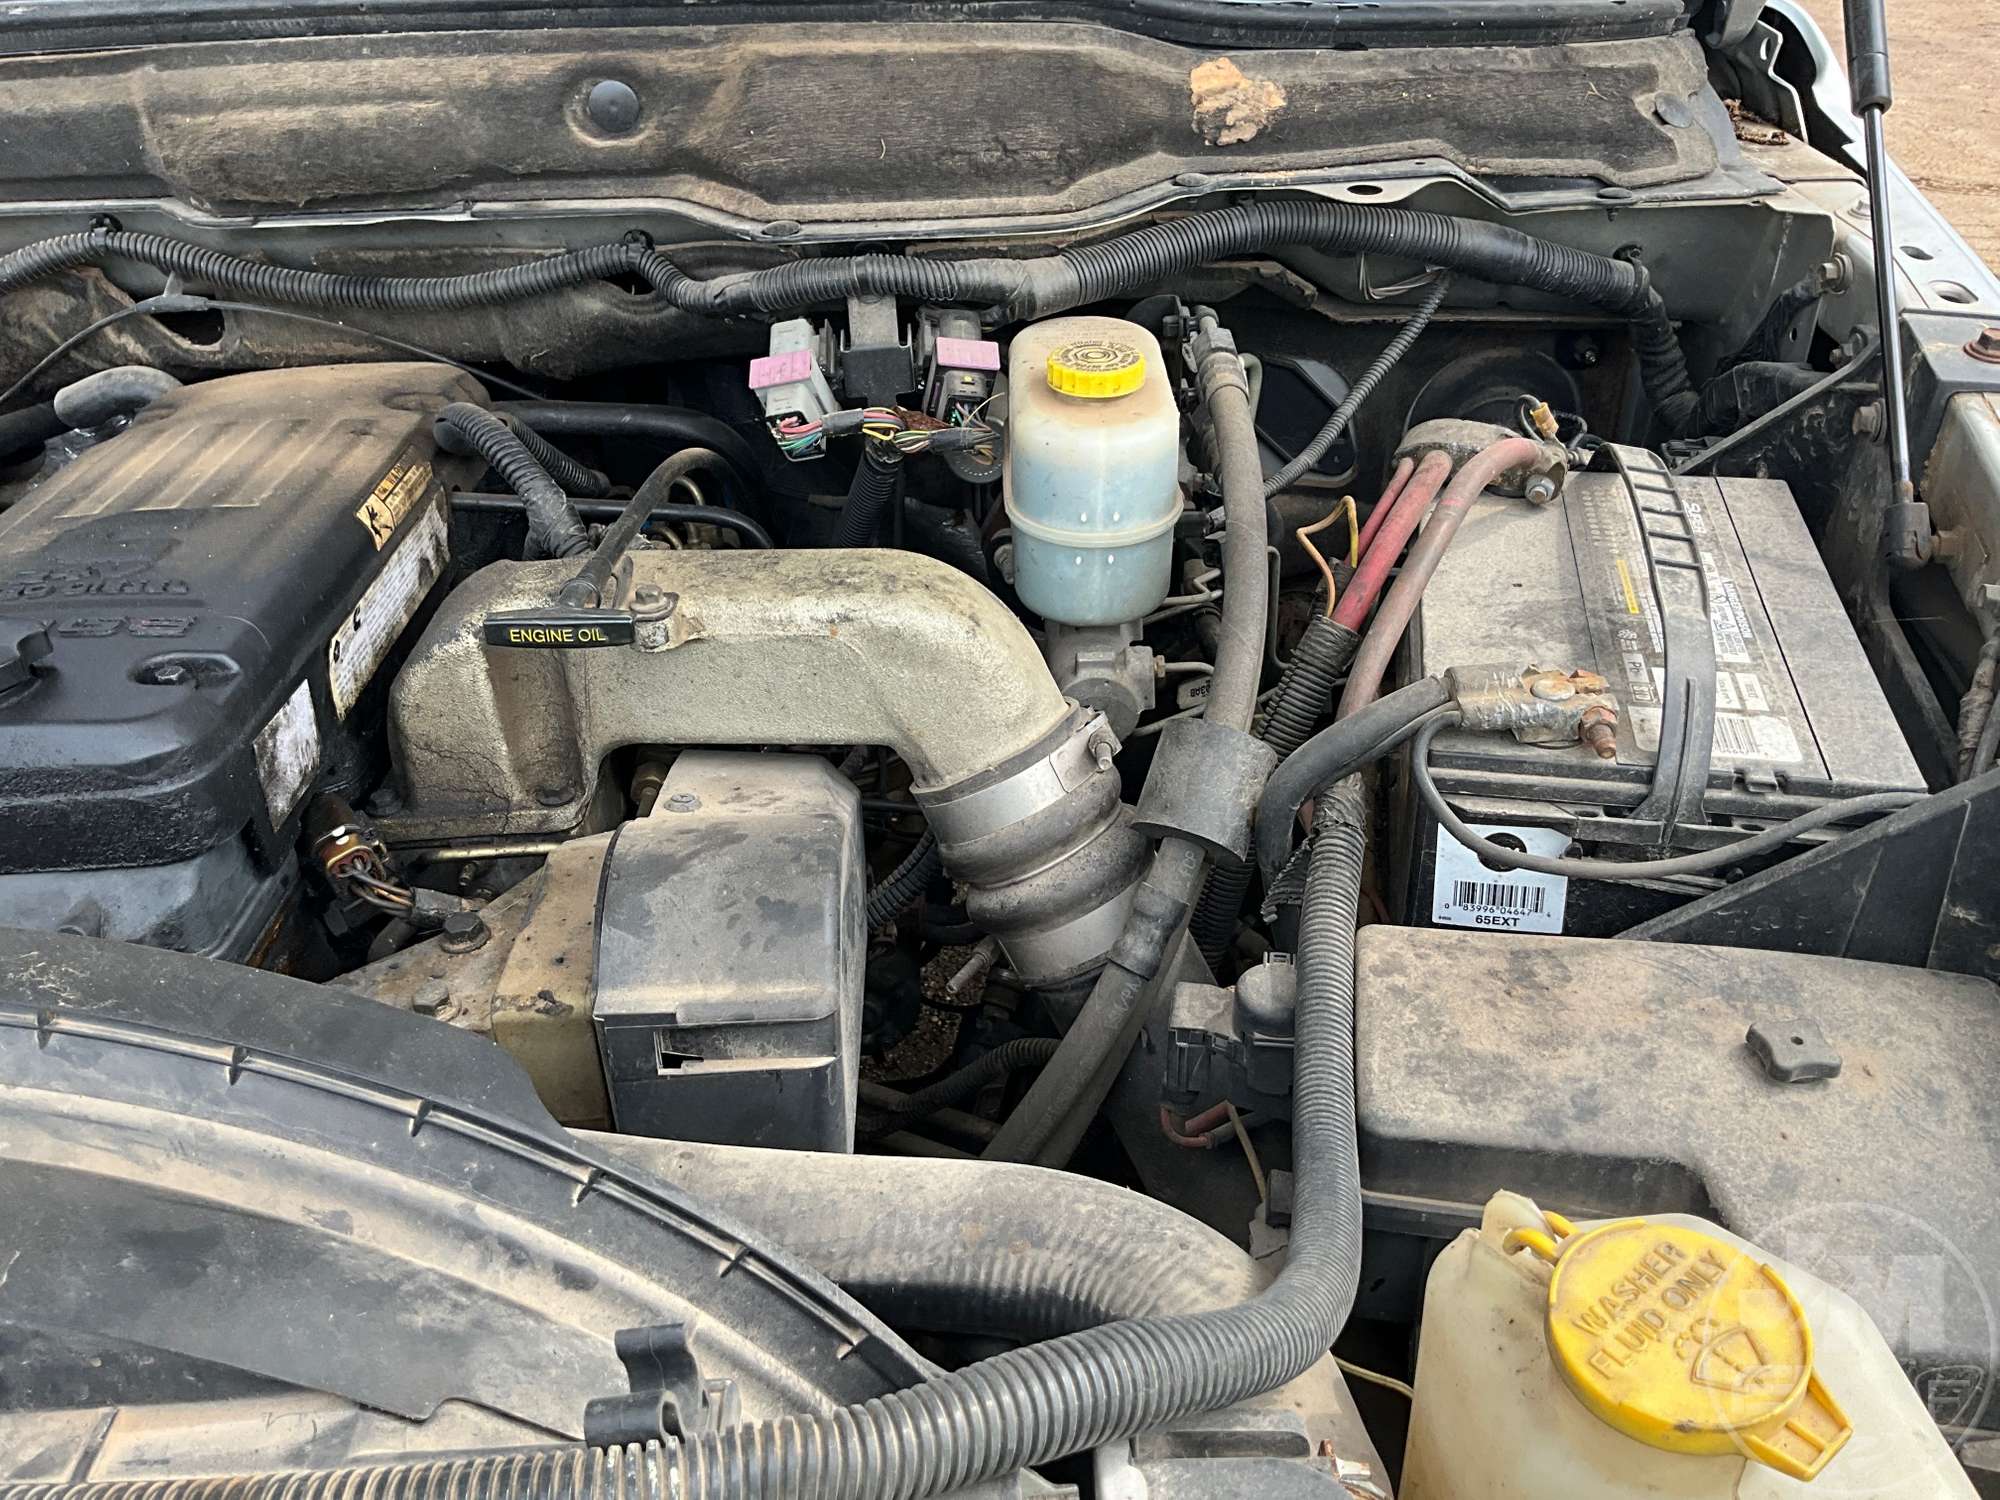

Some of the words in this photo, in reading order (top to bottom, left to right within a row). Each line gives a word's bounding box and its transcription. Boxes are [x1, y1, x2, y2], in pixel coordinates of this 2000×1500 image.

[509, 628, 573, 643] ENGINE
[578, 628, 607, 642] OIL
[1462, 903, 1495, 914] 83996
[1499, 907, 1532, 916] 04647
[1475, 914, 1520, 927] 65EXT
[1571, 1241, 1686, 1337] WASHER
[1588, 1309, 1668, 1380] FLUID
[1661, 1248, 1727, 1312] ONLY
